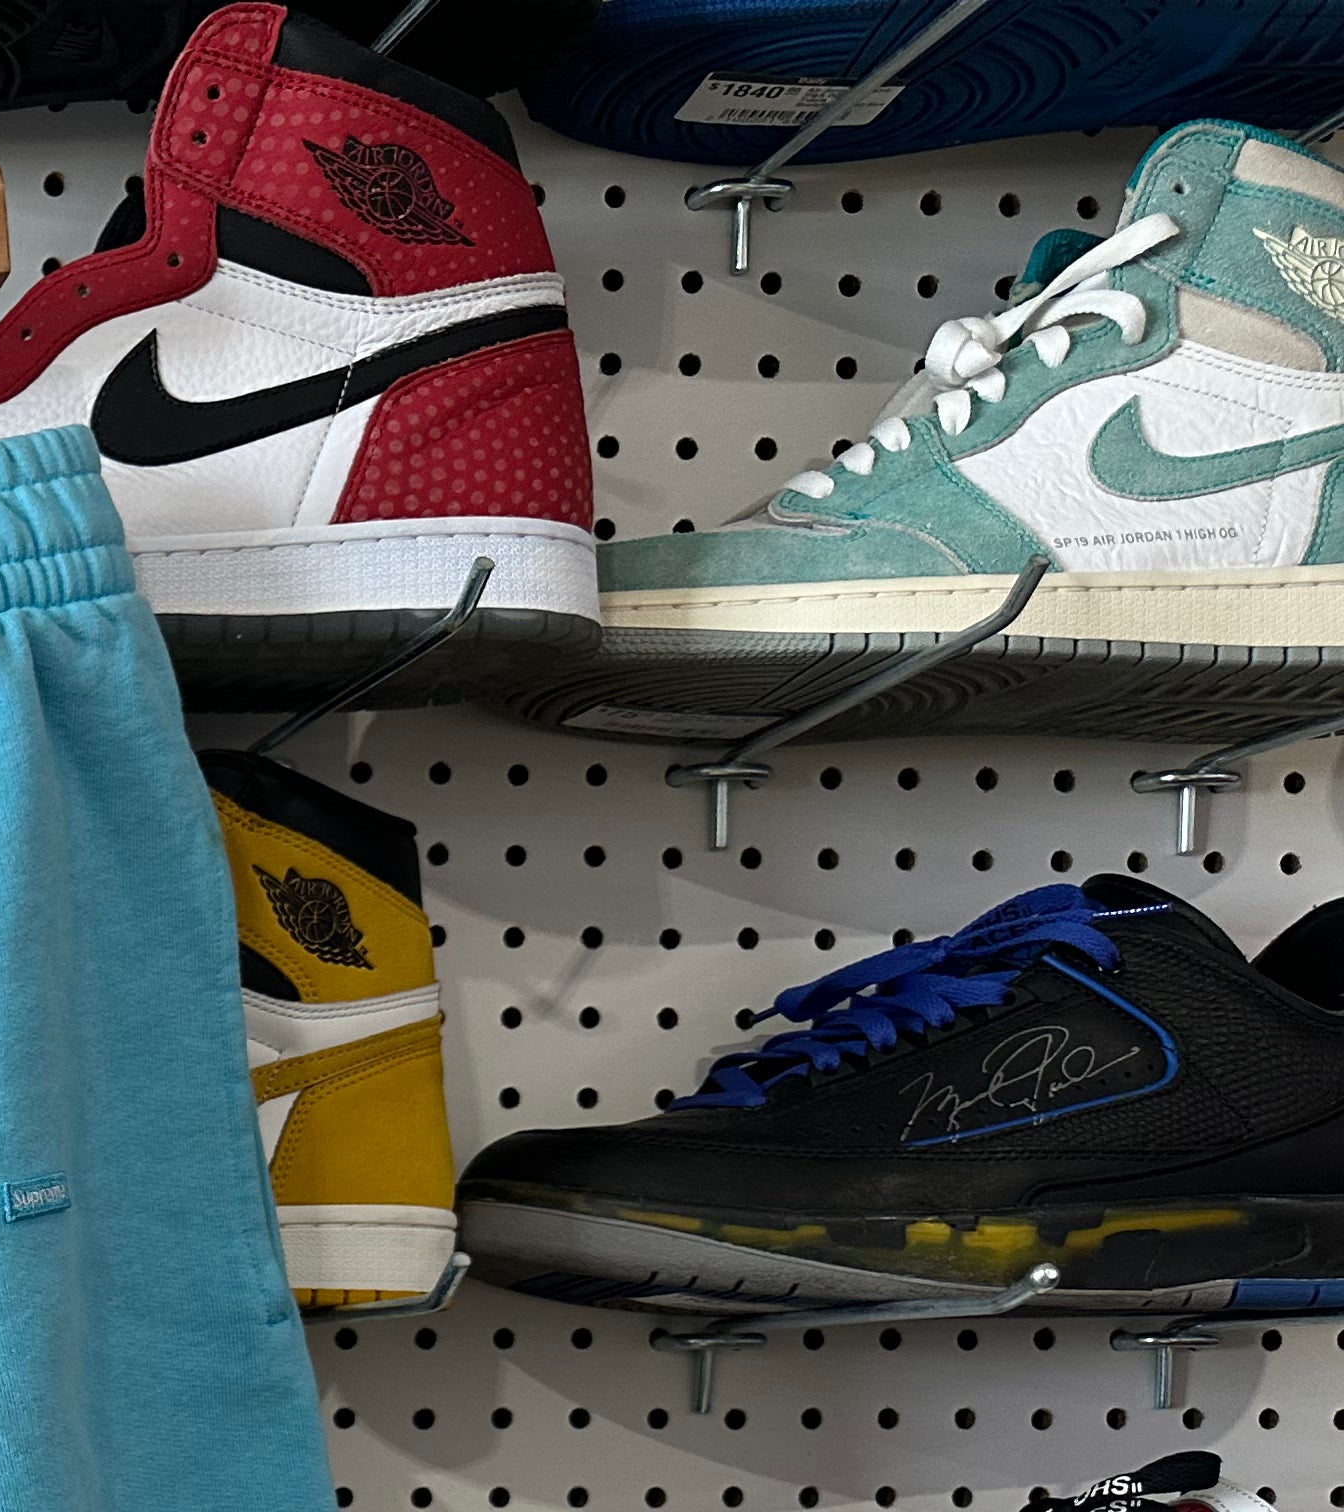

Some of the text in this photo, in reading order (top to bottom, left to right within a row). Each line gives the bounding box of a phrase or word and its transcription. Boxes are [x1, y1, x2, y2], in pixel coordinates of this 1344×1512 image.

[708, 82, 785, 99] $1840
[347, 147, 448, 217] AIR JORDAN
[1054, 537, 1071, 548] SP
[1074, 537, 1088, 547] 19
[1093, 534, 1115, 546] AIR
[1120, 530, 1172, 545] JORDAN
[1184, 528, 1216, 540] HIGH
[1219, 526, 1238, 539] OG
